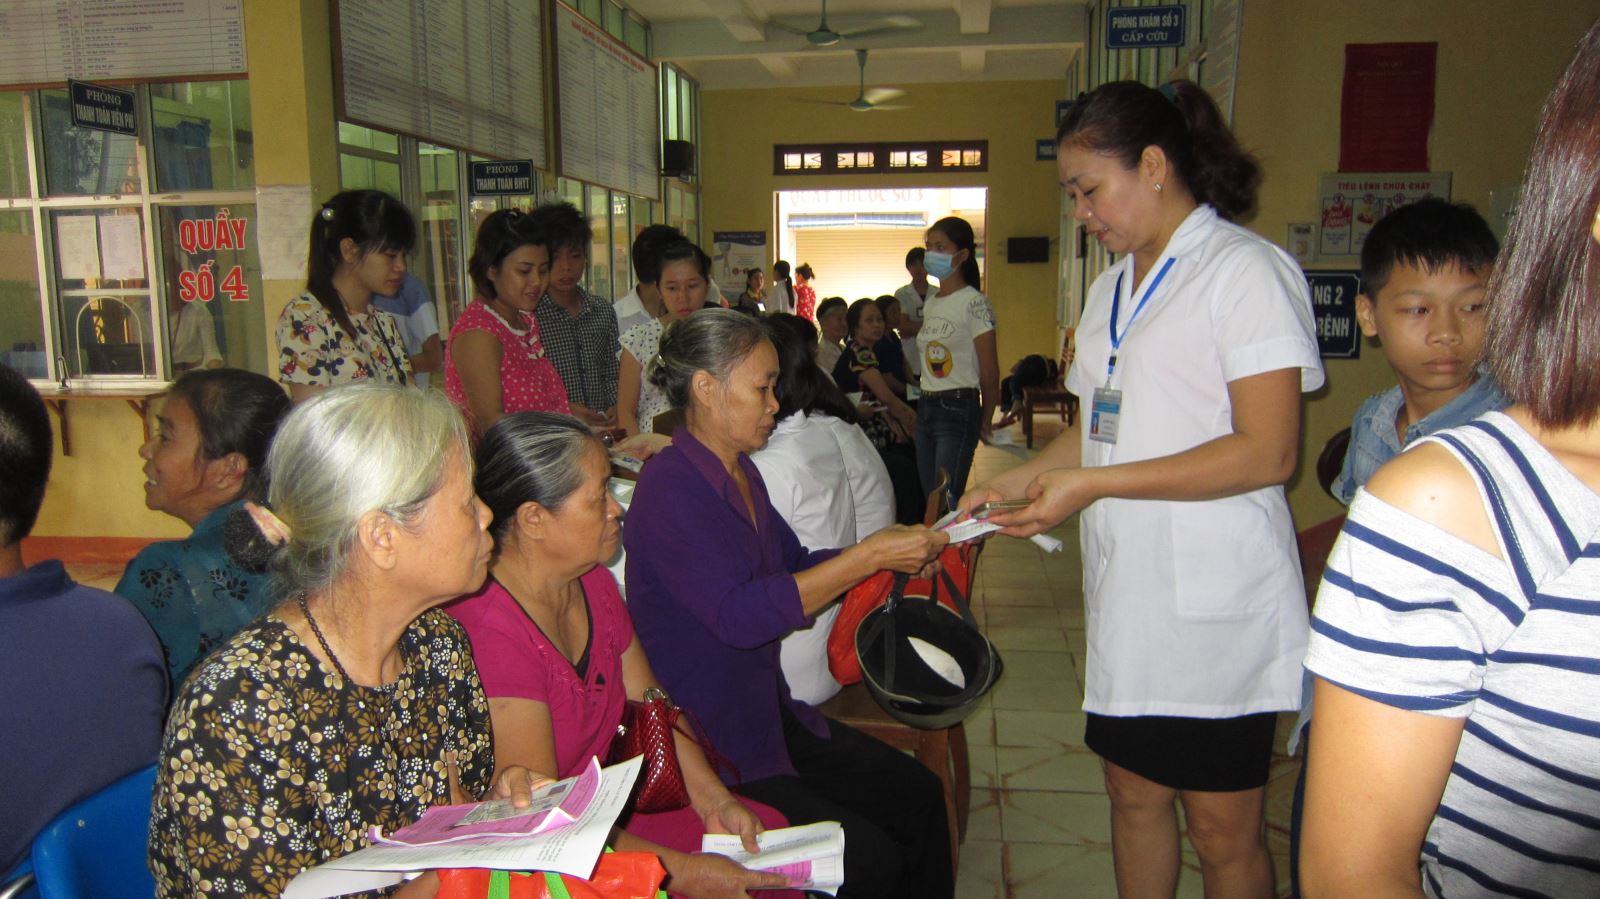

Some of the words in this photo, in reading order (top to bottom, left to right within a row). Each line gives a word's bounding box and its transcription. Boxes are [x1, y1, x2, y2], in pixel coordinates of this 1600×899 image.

[1112, 13, 1137, 29] PHÒNG
[1139, 12, 1160, 28] KHÁM
[1162, 10, 1173, 27] SỐ
[1174, 14, 1179, 27] 3
[86, 88, 121, 105] PHÒNG
[75, 103, 96, 121] THANH
[486, 164, 518, 174] PHÒNG
[476, 177, 497, 190] THANH
[497, 175, 514, 190] TOÁN
[179, 208, 247, 254] QUẦY
[179, 260, 214, 302] SỐ
[220, 265, 249, 301] 4
[1334, 285, 1344, 305] 2
[1316, 313, 1350, 341] BỆNH
